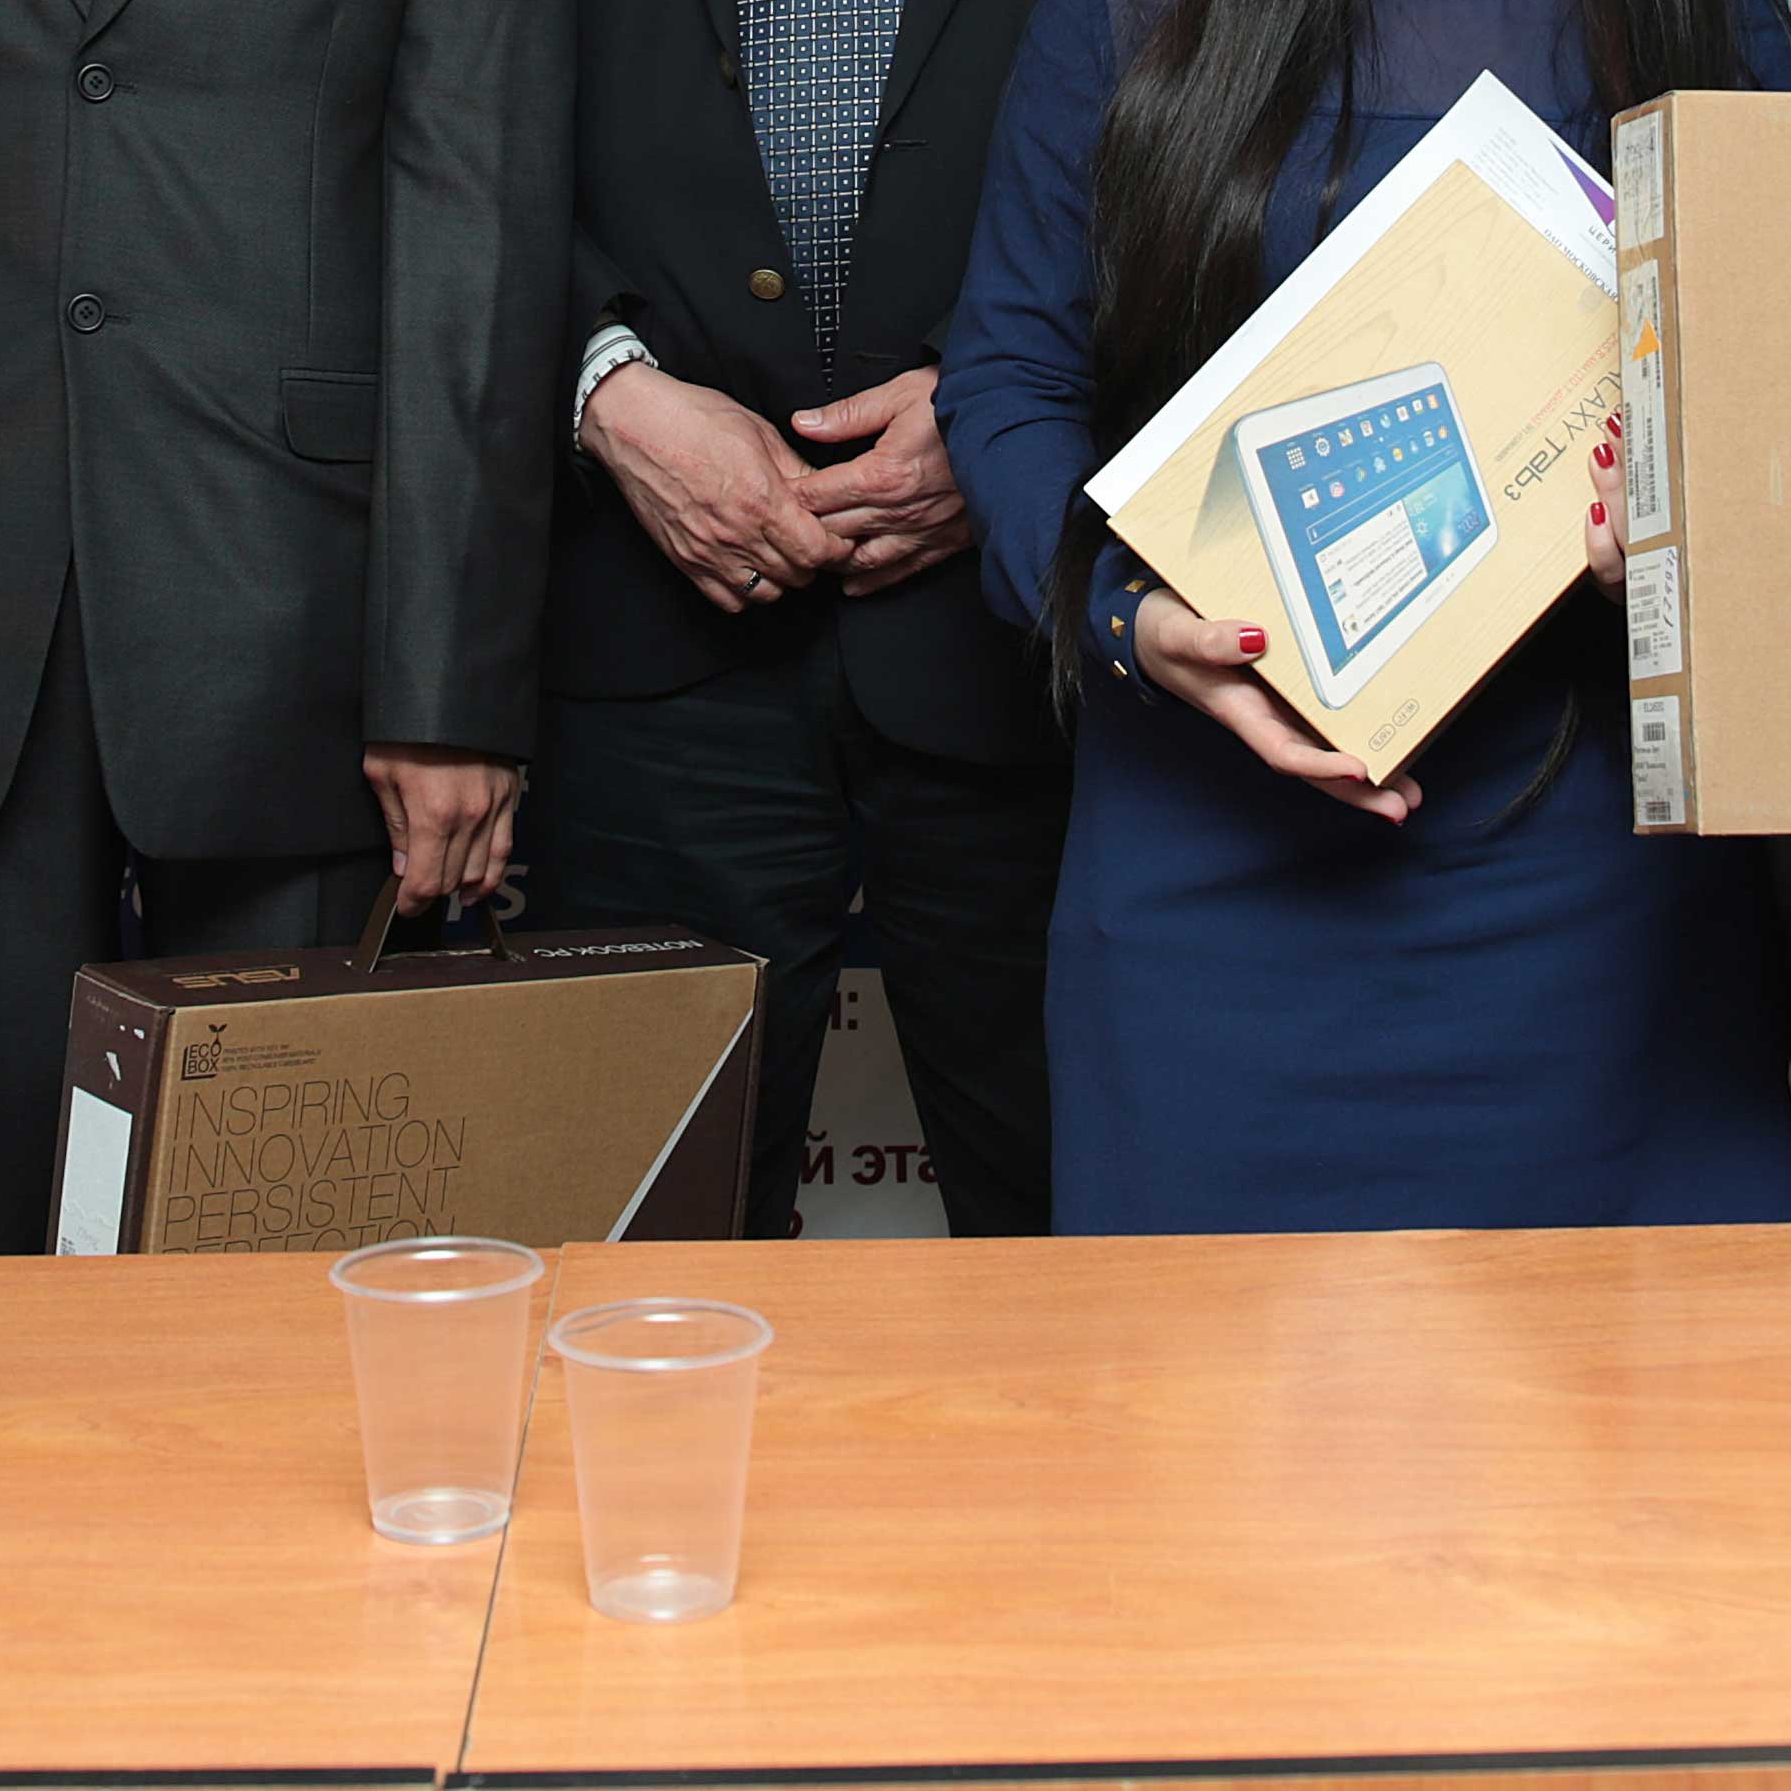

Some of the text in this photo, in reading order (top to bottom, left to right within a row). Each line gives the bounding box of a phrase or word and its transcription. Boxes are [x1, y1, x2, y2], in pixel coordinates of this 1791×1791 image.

[1514, 437, 1567, 486] Tab
[532, 939, 705, 959] NOTEBOOK PC
[171, 966, 301, 989] ASUS
[186, 1059, 220, 1074] BOX
[188, 1039, 223, 1060] ECO
[173, 1071, 410, 1141] INSPIRING
[168, 1115, 467, 1193] INNOVATION
[162, 1165, 461, 1245] PERSISTENT
